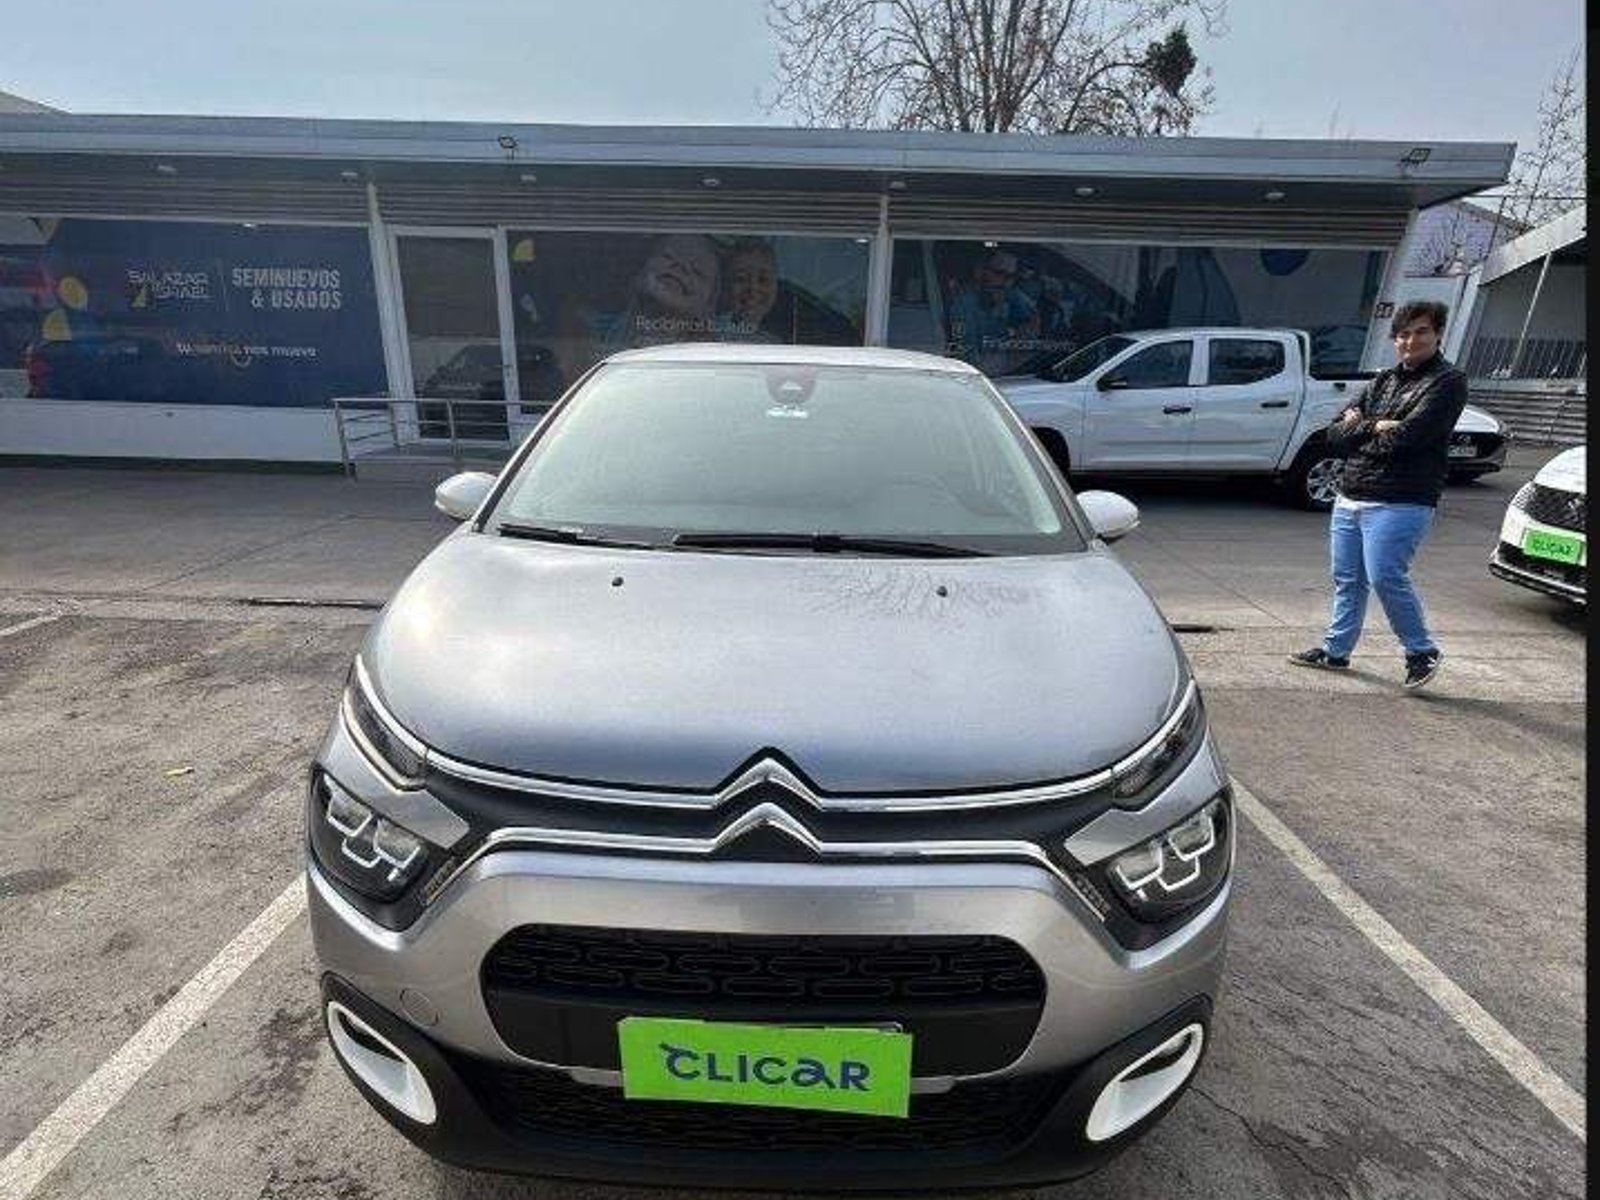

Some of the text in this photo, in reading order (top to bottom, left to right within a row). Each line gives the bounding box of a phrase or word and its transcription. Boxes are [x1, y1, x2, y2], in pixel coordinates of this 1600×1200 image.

[231, 267, 342, 290] SEMINUEVOS
[251, 289, 343, 310] & USADOS
